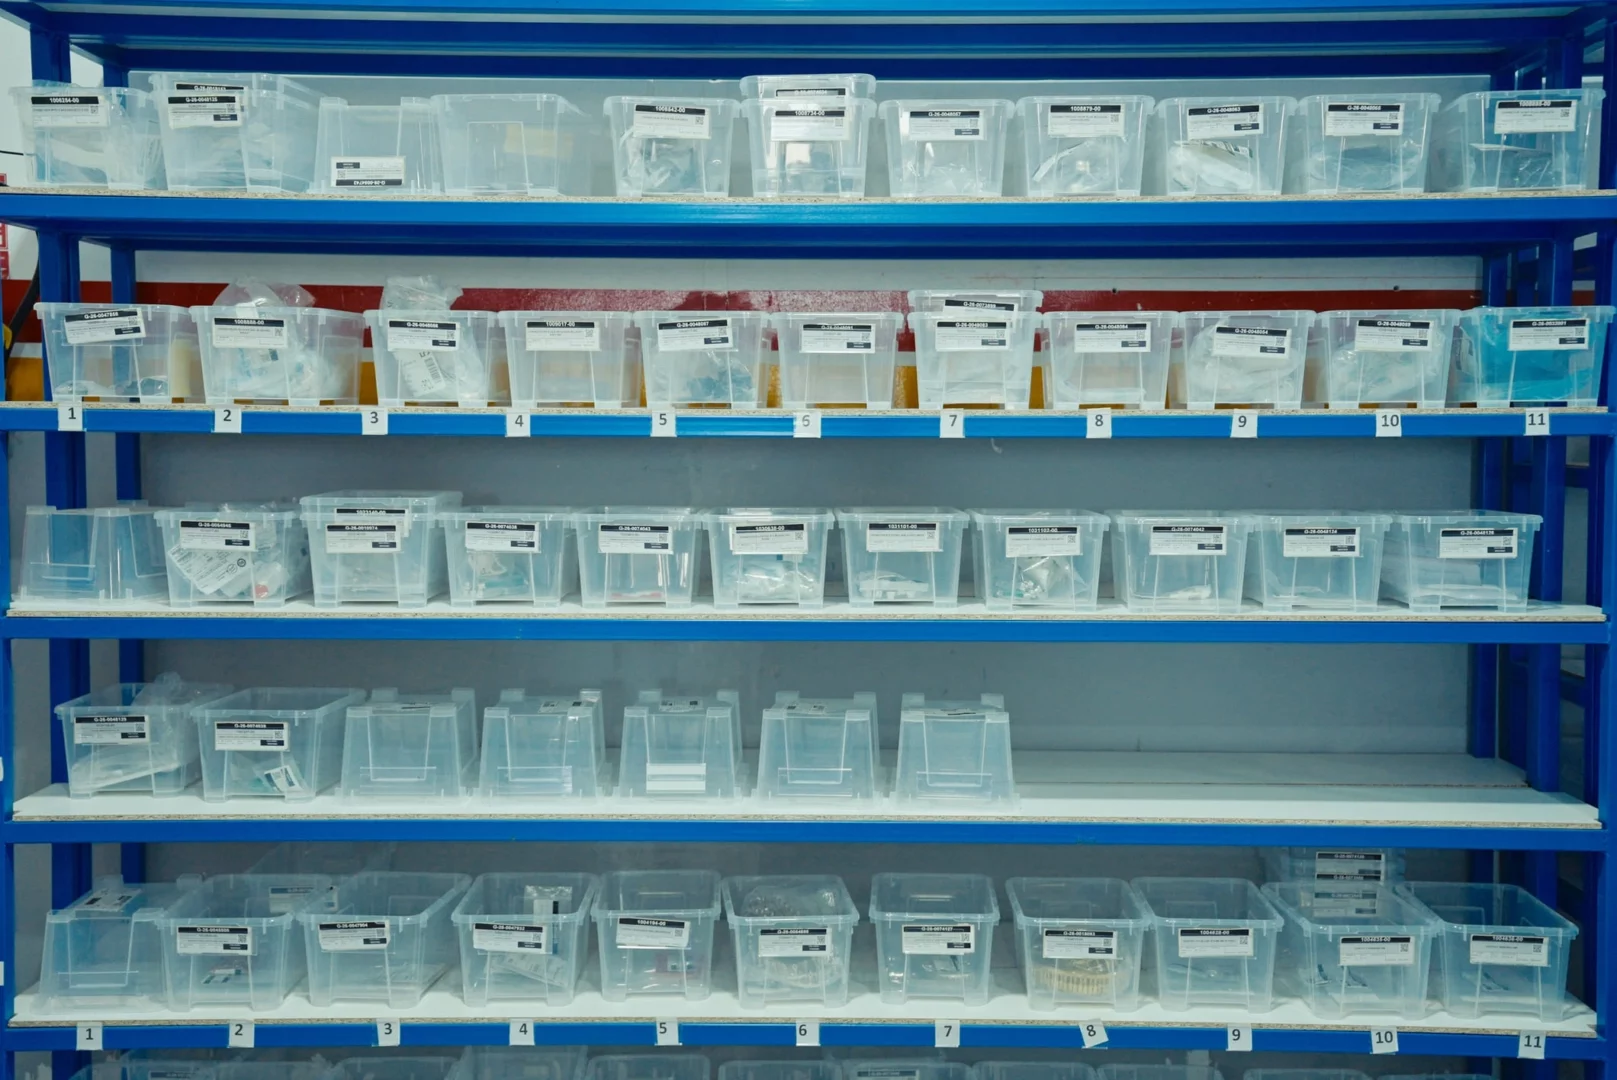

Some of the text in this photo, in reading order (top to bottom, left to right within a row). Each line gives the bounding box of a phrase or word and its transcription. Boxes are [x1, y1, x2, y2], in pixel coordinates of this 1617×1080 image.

[68, 407, 77, 420] 1
[223, 409, 232, 422] 2
[370, 411, 379, 424] 3
[659, 413, 667, 426] 5
[1528, 413, 1545, 426] 11
[514, 414, 524, 427] 4
[801, 414, 810, 428] 6
[949, 414, 958, 427] 7
[1095, 414, 1104, 427] 8
[1238, 415, 1247, 428] 9
[1381, 414, 1400, 427] 10
[85, 1027, 94, 1041] 1
[234, 1023, 243, 1036] 2
[384, 1022, 393, 1035] 3
[519, 1022, 528, 1035] 4
[659, 1021, 667, 1035] 5
[798, 1024, 808, 1037] 6
[944, 1025, 953, 1037] 7
[1086, 1024, 1097, 1037] 8
[1231, 1028, 1241, 1041] 9
[1375, 1030, 1394, 1044] 10
[1524, 1034, 1542, 1049] 11
